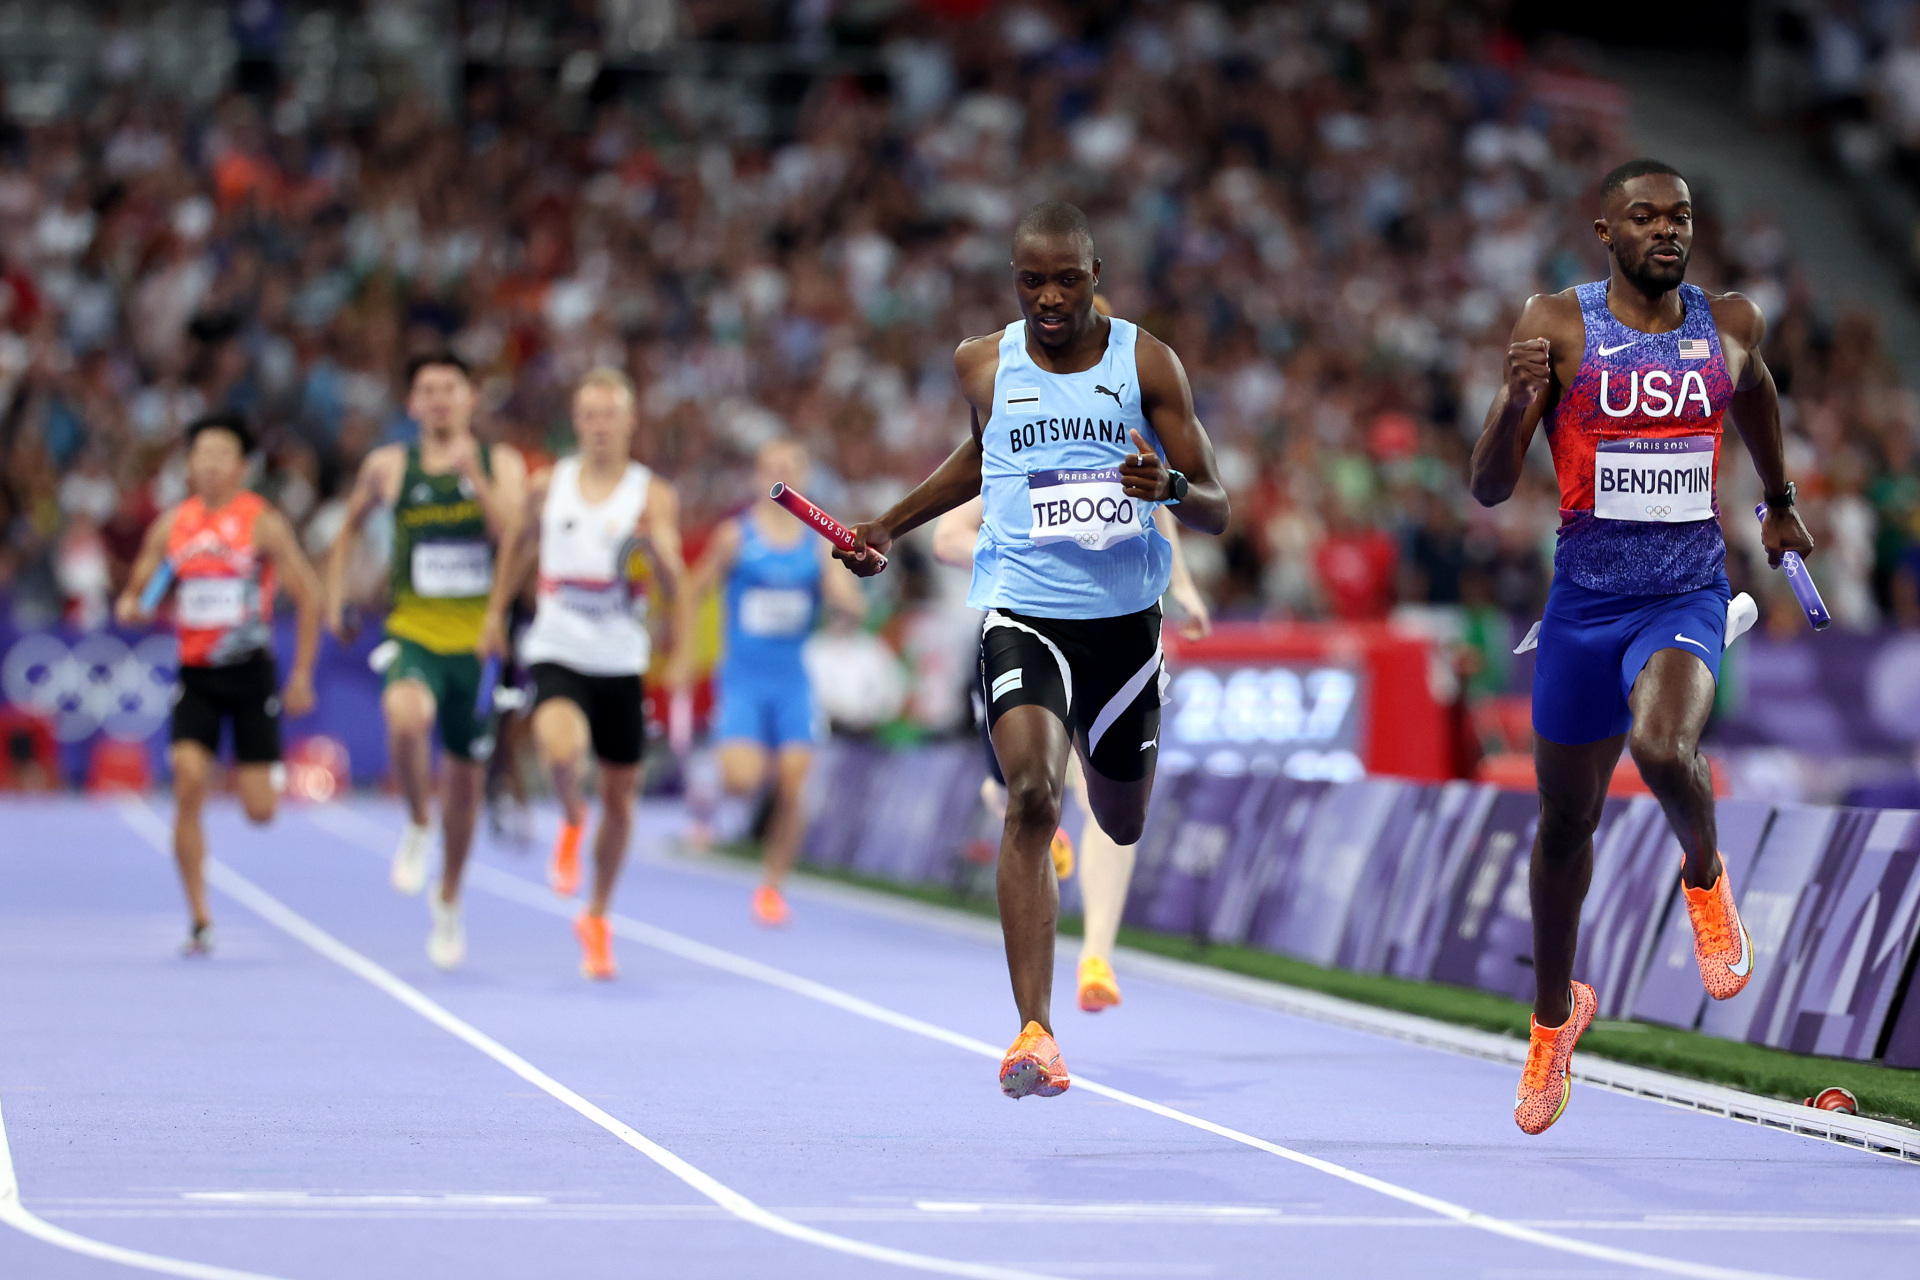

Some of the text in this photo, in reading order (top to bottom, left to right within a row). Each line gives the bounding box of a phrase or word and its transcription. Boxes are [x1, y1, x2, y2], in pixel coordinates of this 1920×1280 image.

[1599, 370, 1712, 418] USA
[1009, 417, 1126, 454] BOTSWANA
[1629, 441, 1689, 450] PARIS 2024
[1057, 471, 1117, 481] PARIS 2024
[1600, 466, 1710, 495] BENJAMIN
[808, 507, 835, 530] 2024
